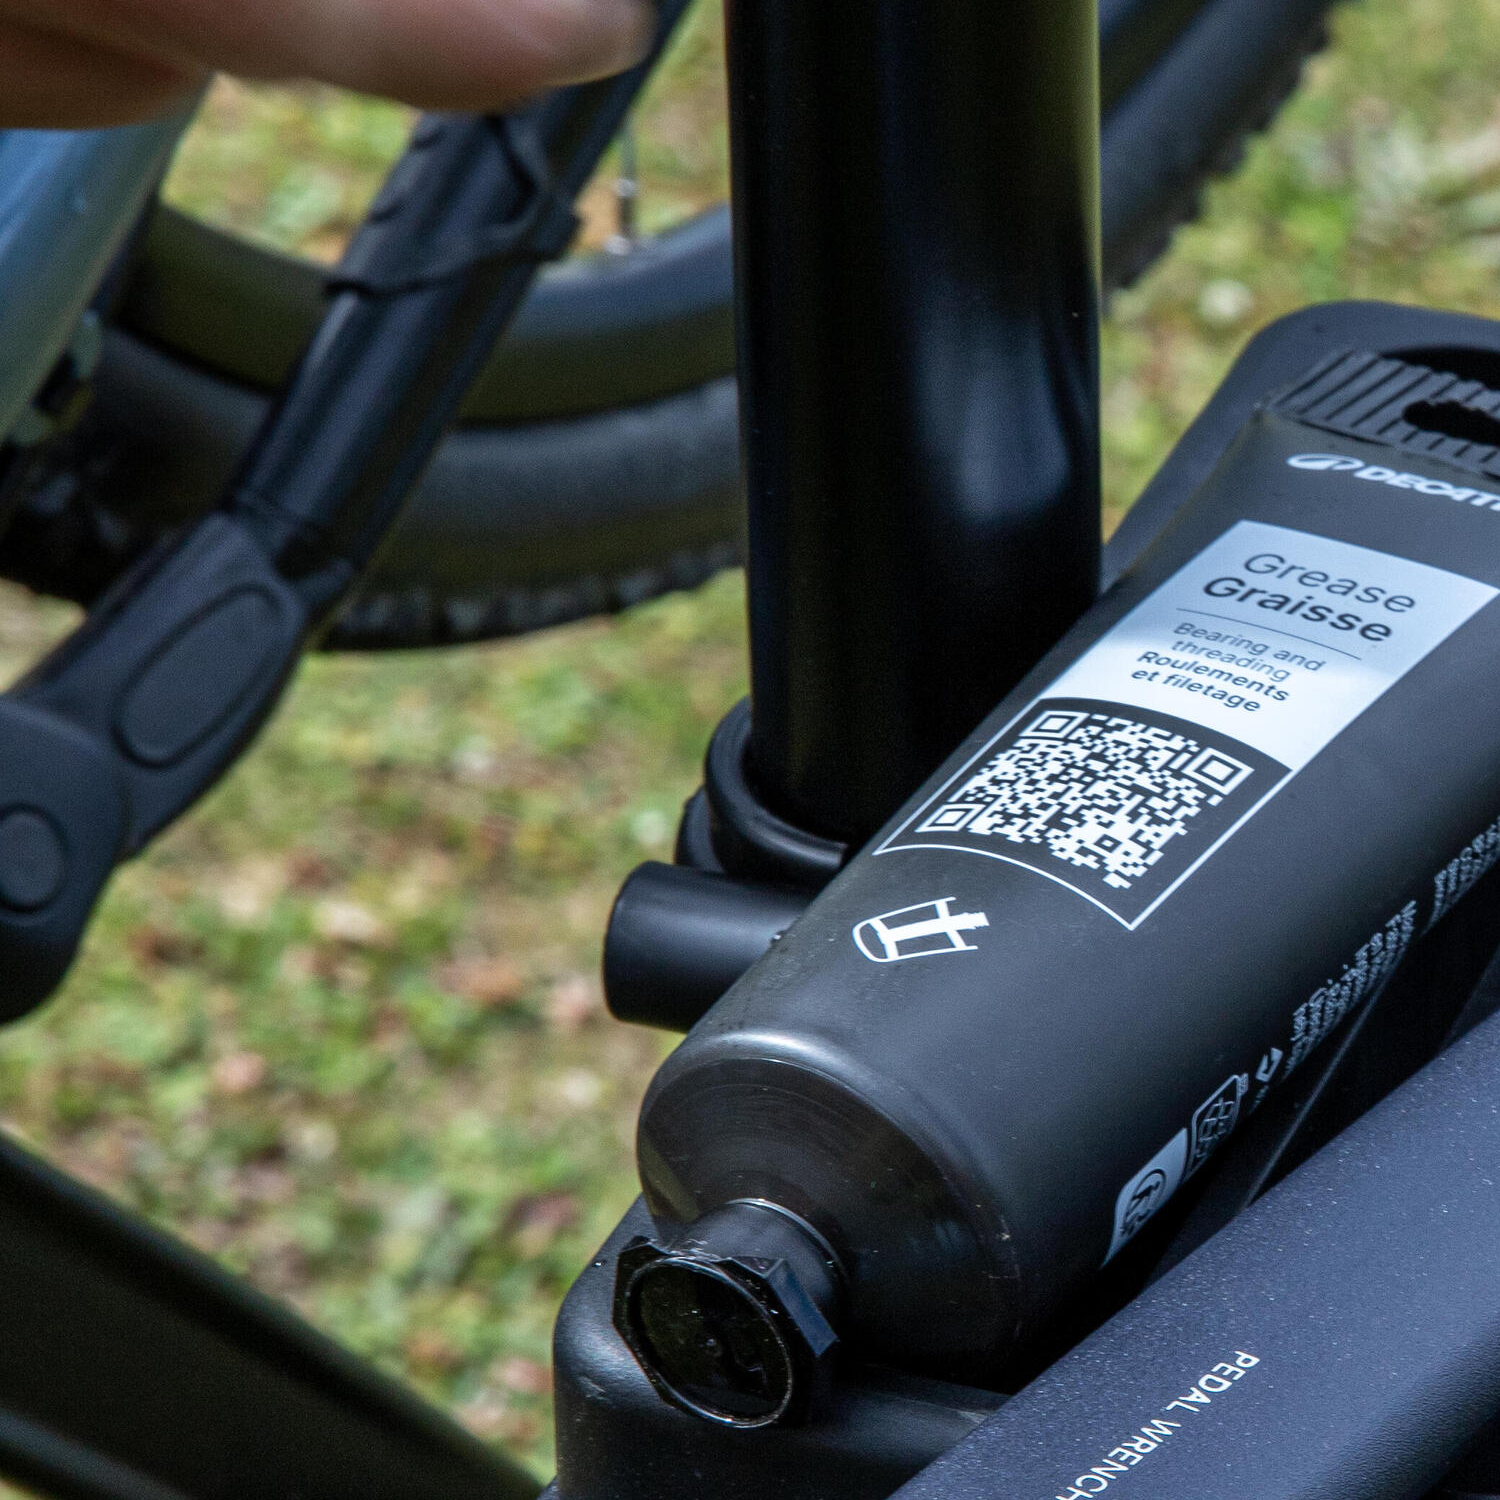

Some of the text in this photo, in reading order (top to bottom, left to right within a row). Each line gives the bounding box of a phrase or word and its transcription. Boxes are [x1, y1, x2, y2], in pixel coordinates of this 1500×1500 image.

[1244, 553, 1416, 613] Grease
[1203, 576, 1392, 642] Graisse
[1171, 640, 1292, 683] threading
[1173, 622, 1327, 672] Bearing and
[1131, 669, 1262, 712] et filetage
[1136, 651, 1291, 702] Roulements
[1165, 1350, 1260, 1413] PEDAL
